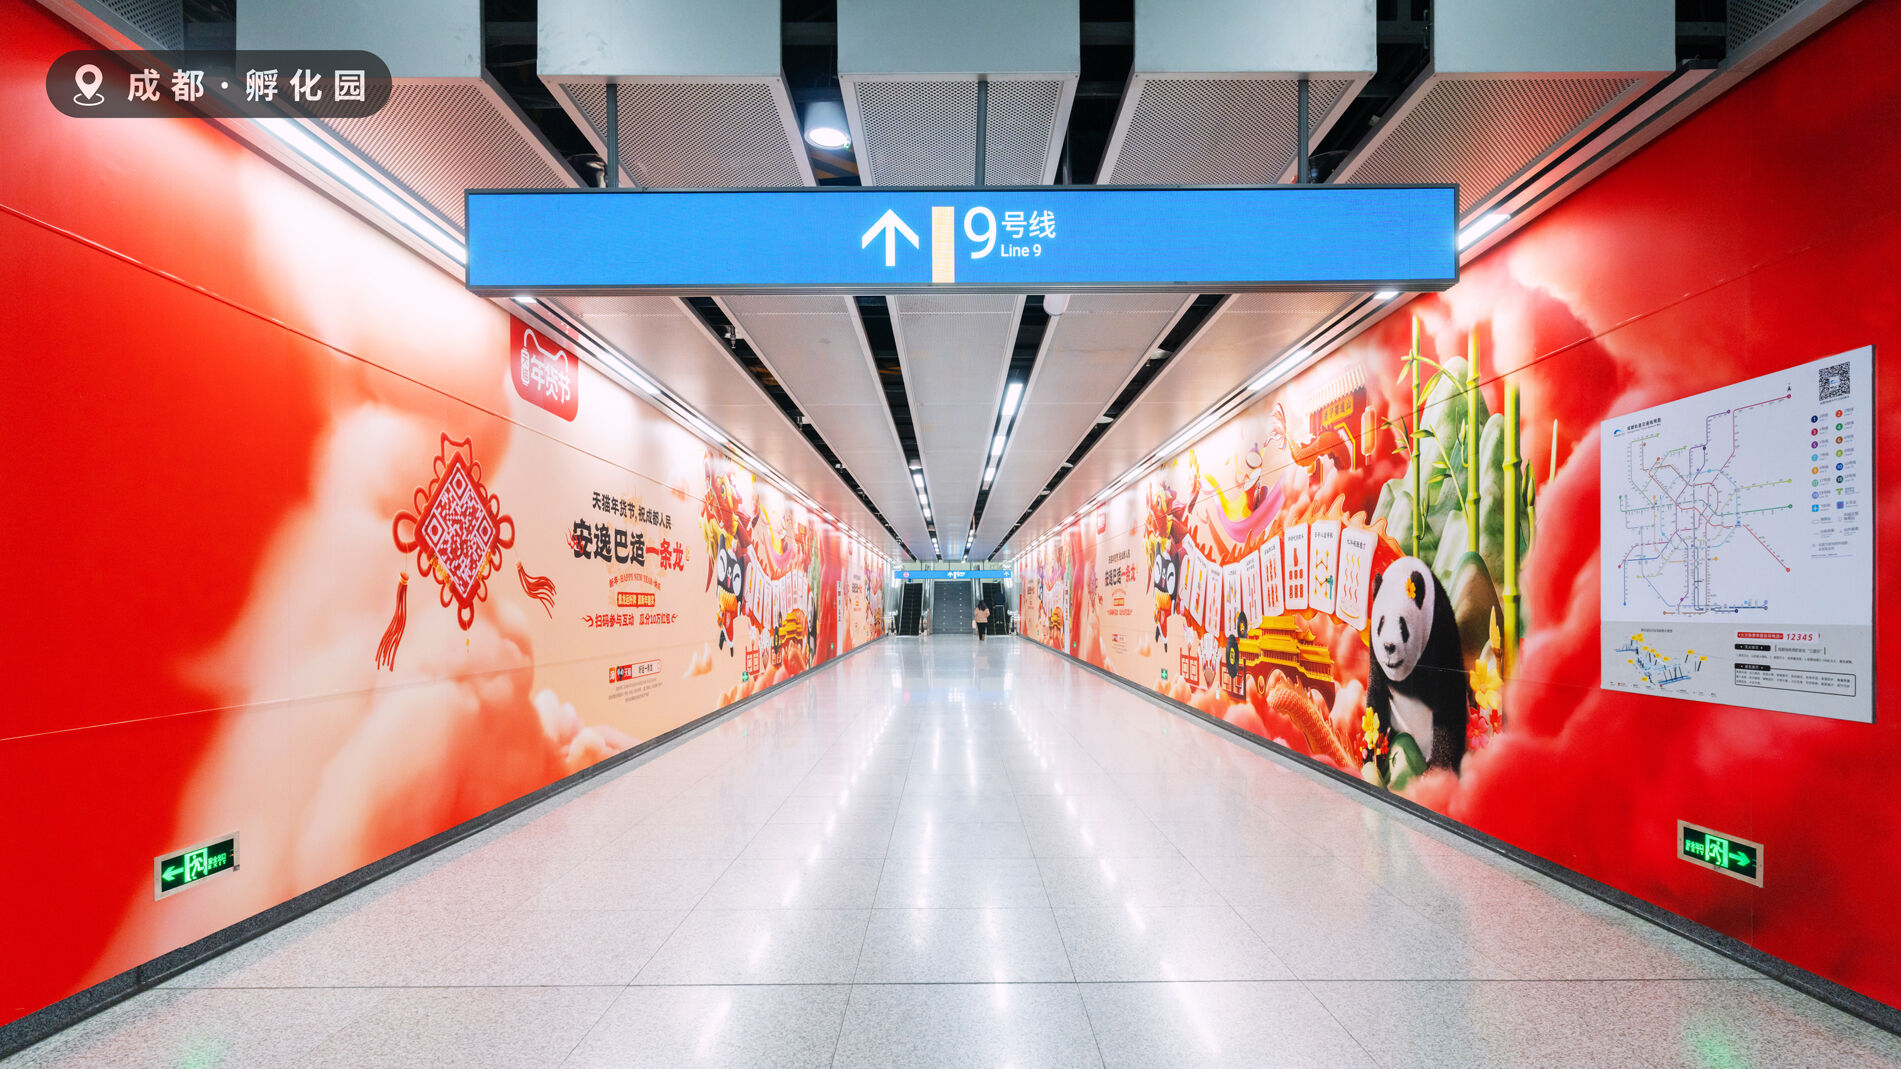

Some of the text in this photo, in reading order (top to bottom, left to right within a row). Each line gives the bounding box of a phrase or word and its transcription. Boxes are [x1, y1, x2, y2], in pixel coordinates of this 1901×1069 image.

[1001, 210, 1057, 239] 号线
[1000, 243, 1042, 258] Line 9
[572, 518, 685, 571] 安逸巴适一条龙
[595, 613, 635, 628] 扫码参与互动
[1786, 633, 1814, 641] 12345
